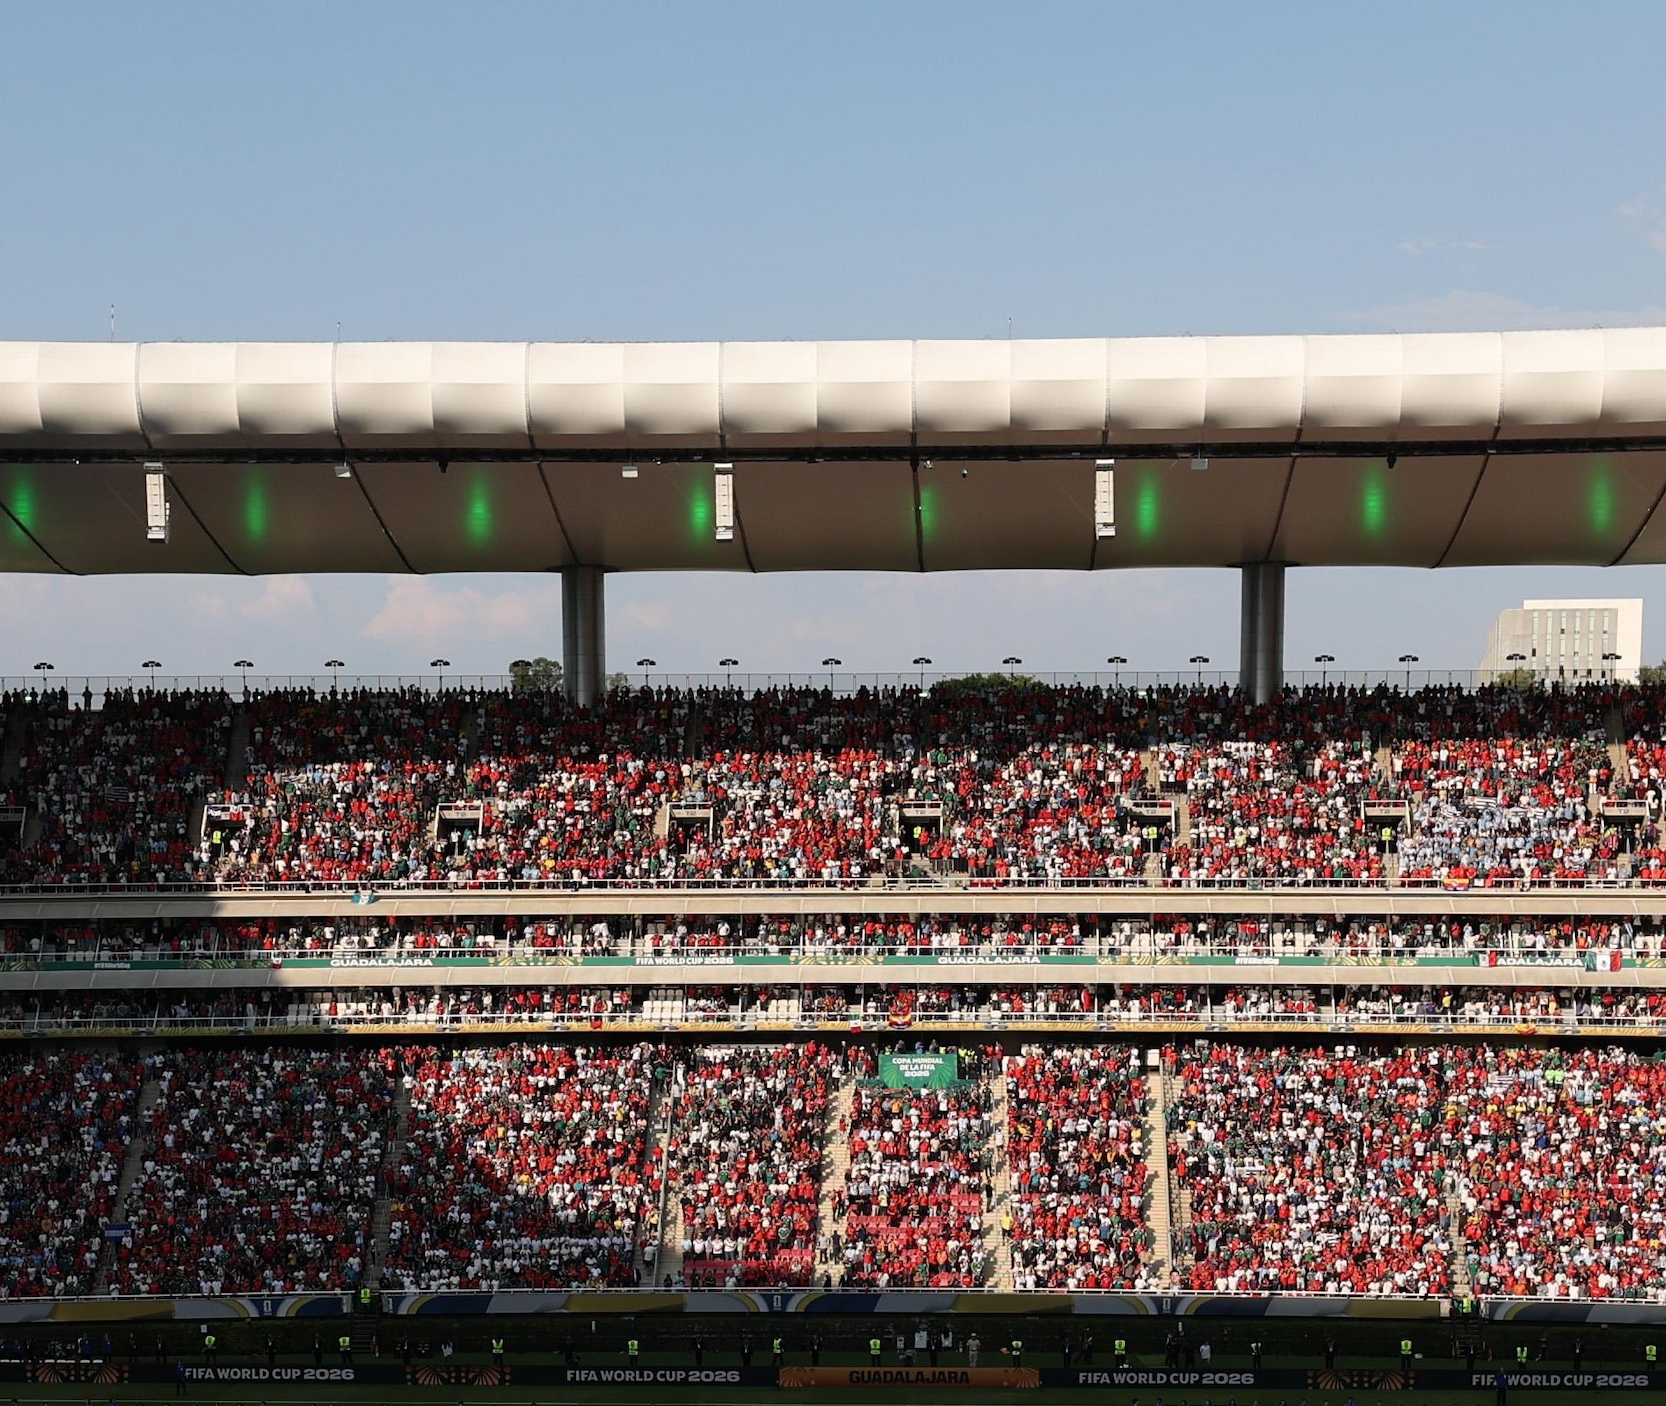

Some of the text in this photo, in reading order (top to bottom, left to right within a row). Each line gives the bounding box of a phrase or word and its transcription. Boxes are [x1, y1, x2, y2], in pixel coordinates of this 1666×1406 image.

[1496, 958, 1584, 966] ADALAJARA
[185, 1368, 355, 1380] FIFA WORLD CUP 2026
[566, 1370, 740, 1382] FIFA WORLD CUP 2026
[850, 1371, 970, 1384] GUADALAJARA
[1078, 1373, 1254, 1384] FIFA WORLD CUP 2026
[1507, 1375, 1561, 1386] WORLD
[1563, 1375, 1593, 1386] CUP
[1596, 1375, 1649, 1386] 2026
